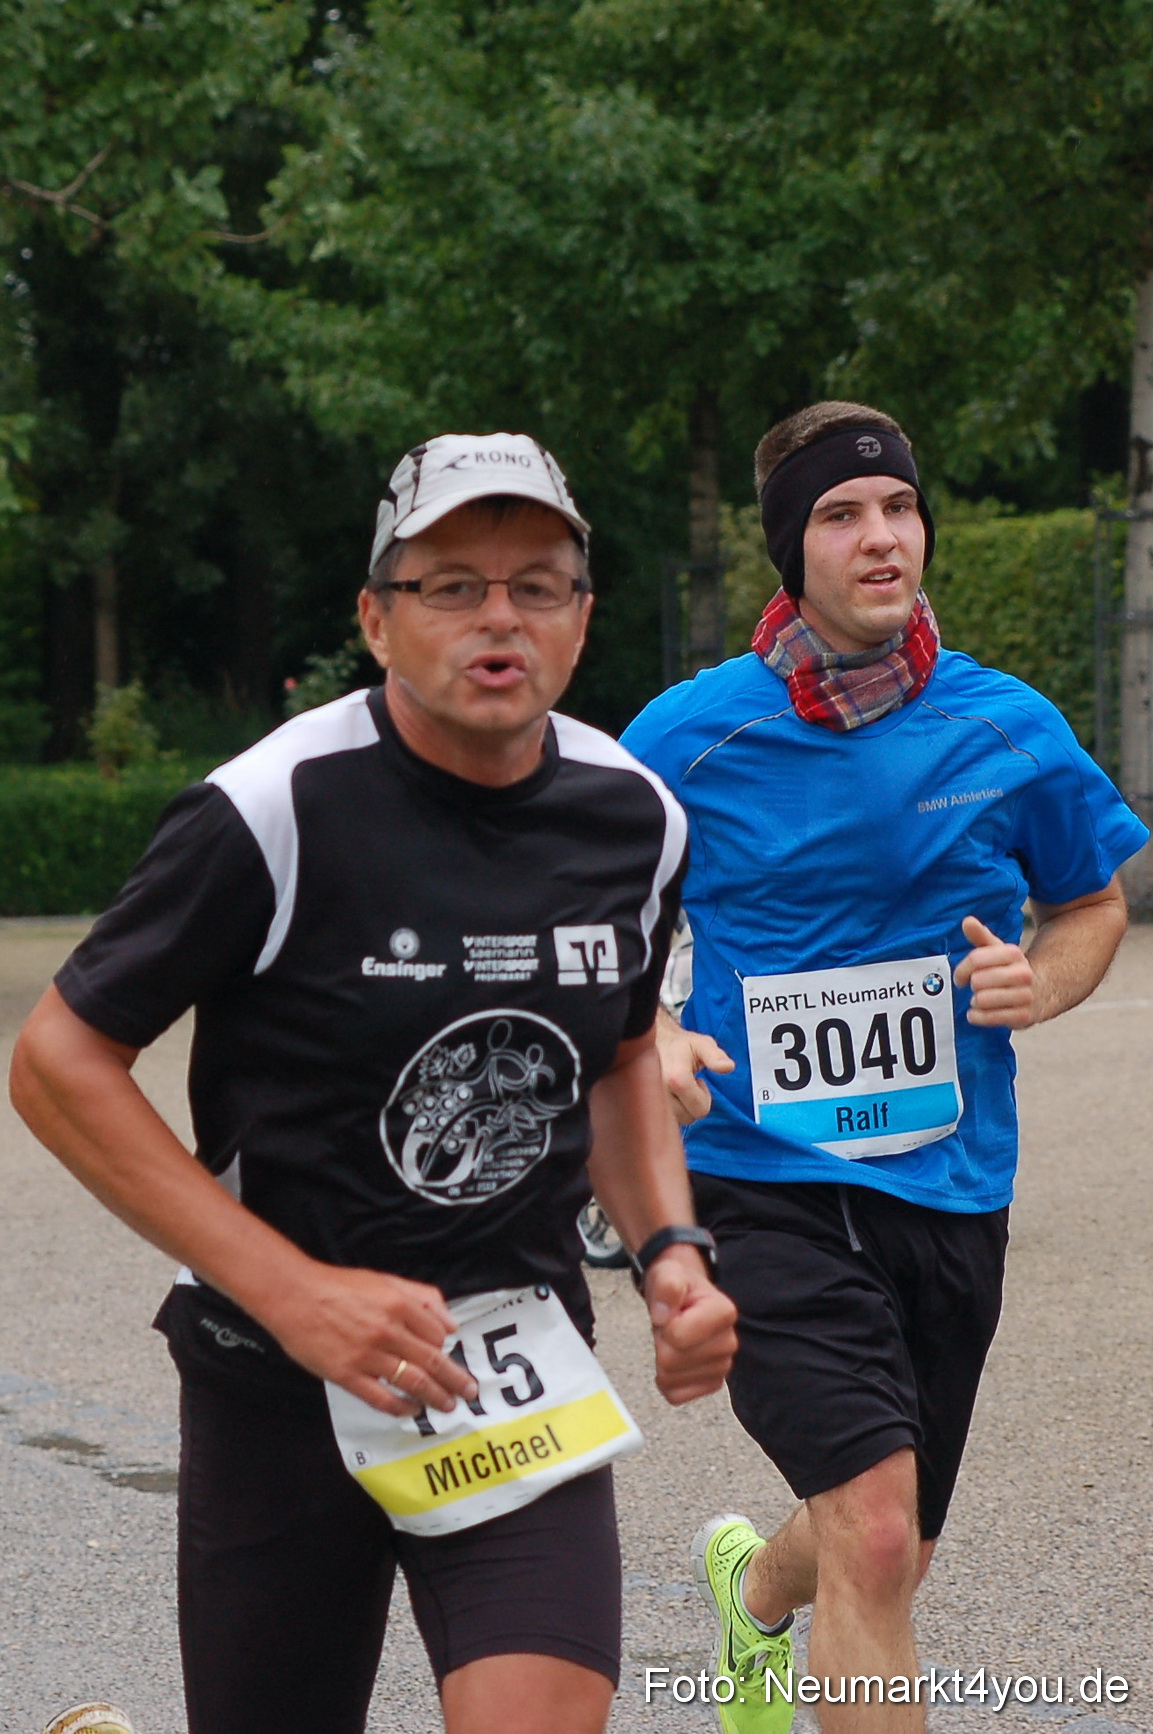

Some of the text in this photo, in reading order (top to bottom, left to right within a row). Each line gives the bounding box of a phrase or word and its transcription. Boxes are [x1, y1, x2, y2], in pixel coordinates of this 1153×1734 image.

[475, 450, 531, 469] RONO
[918, 788, 1004, 813] BMW Athletics
[361, 956, 447, 981] Ensinger
[750, 982, 915, 1014] PARTL Neumarkt
[771, 1007, 937, 1091] 3040
[762, 1090, 770, 1101] B
[836, 1102, 889, 1133] Ralf
[355, 1452, 367, 1465] B
[424, 1424, 563, 1497] Michael
